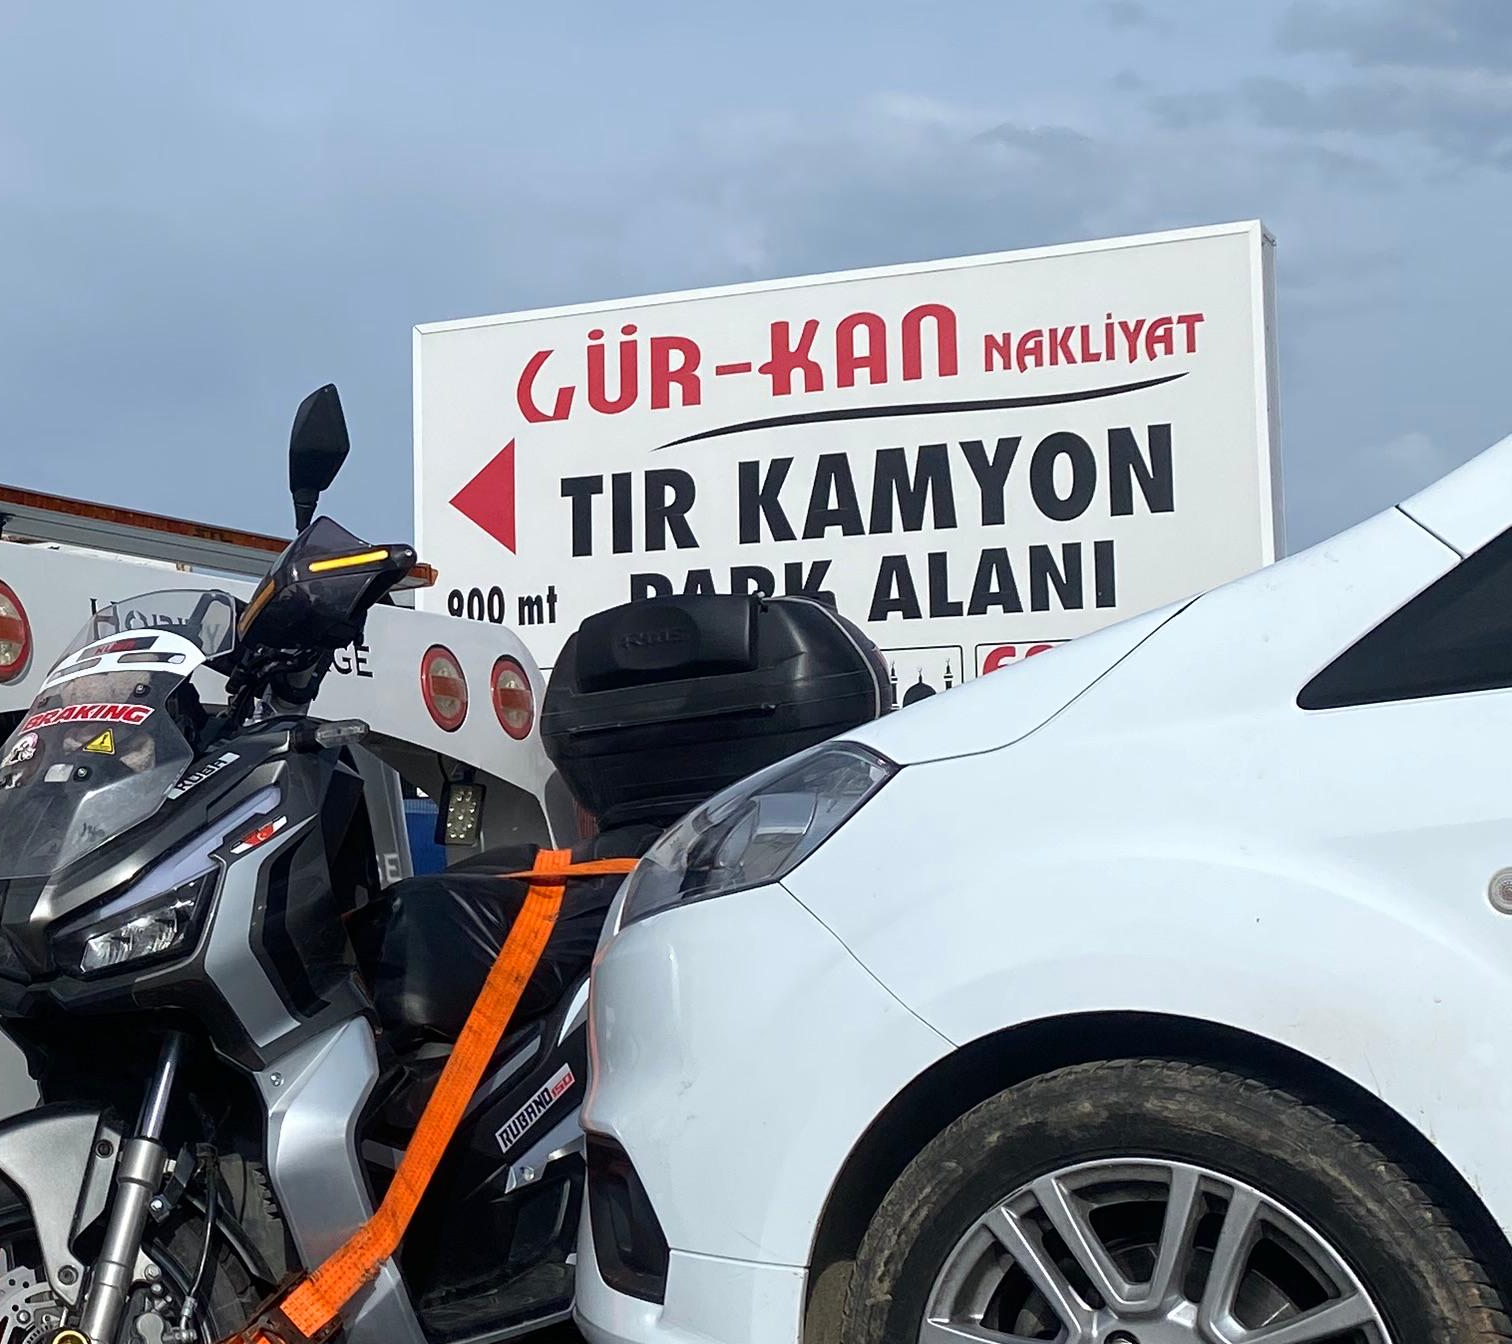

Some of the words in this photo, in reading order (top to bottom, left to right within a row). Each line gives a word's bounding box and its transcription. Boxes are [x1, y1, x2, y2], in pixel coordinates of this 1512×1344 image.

[516, 303, 959, 423] GÜR-KAN
[984, 312, 1205, 374] NAKLİYAT
[560, 468, 700, 558] TIR
[738, 422, 1175, 545] KAMYON
[518, 585, 558, 626] mt
[867, 540, 1117, 622] ALANI
[23, 703, 152, 731] BRAKING
[498, 1087, 553, 1149] RUBANO
